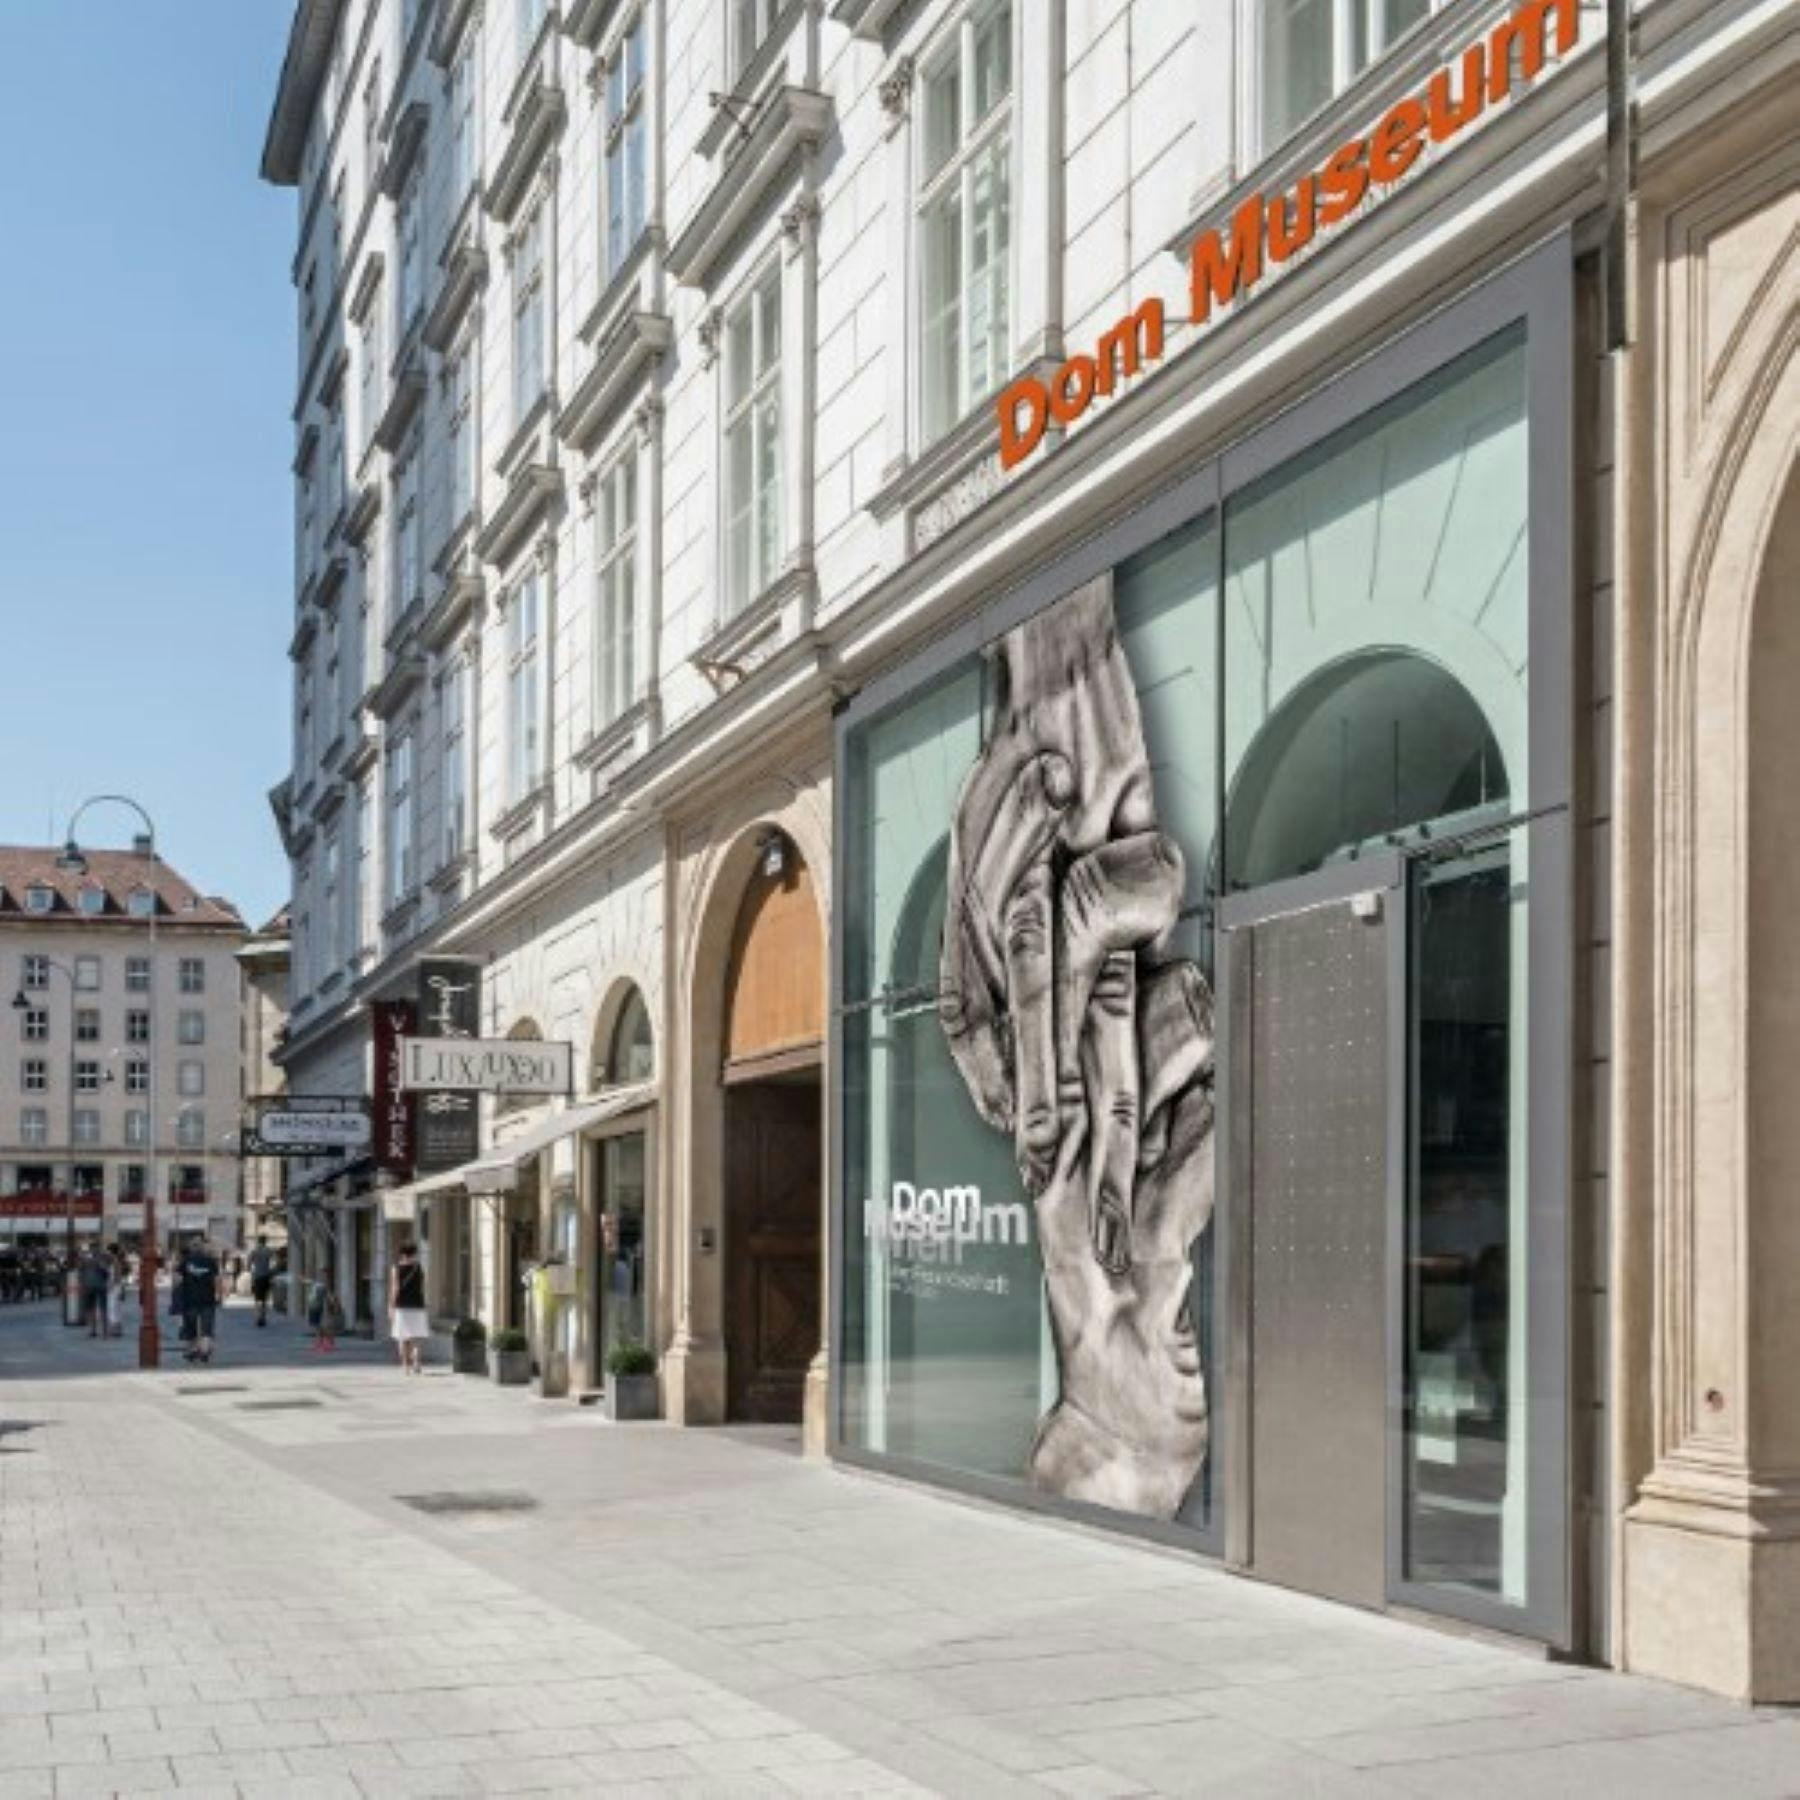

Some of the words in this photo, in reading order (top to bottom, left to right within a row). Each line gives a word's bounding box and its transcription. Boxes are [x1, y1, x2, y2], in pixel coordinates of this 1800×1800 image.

[996, 297, 1164, 472] Dom
[1189, 0, 1578, 325] Museum
[863, 1199, 1029, 1244] Museum
[891, 1181, 981, 1224] Dom
